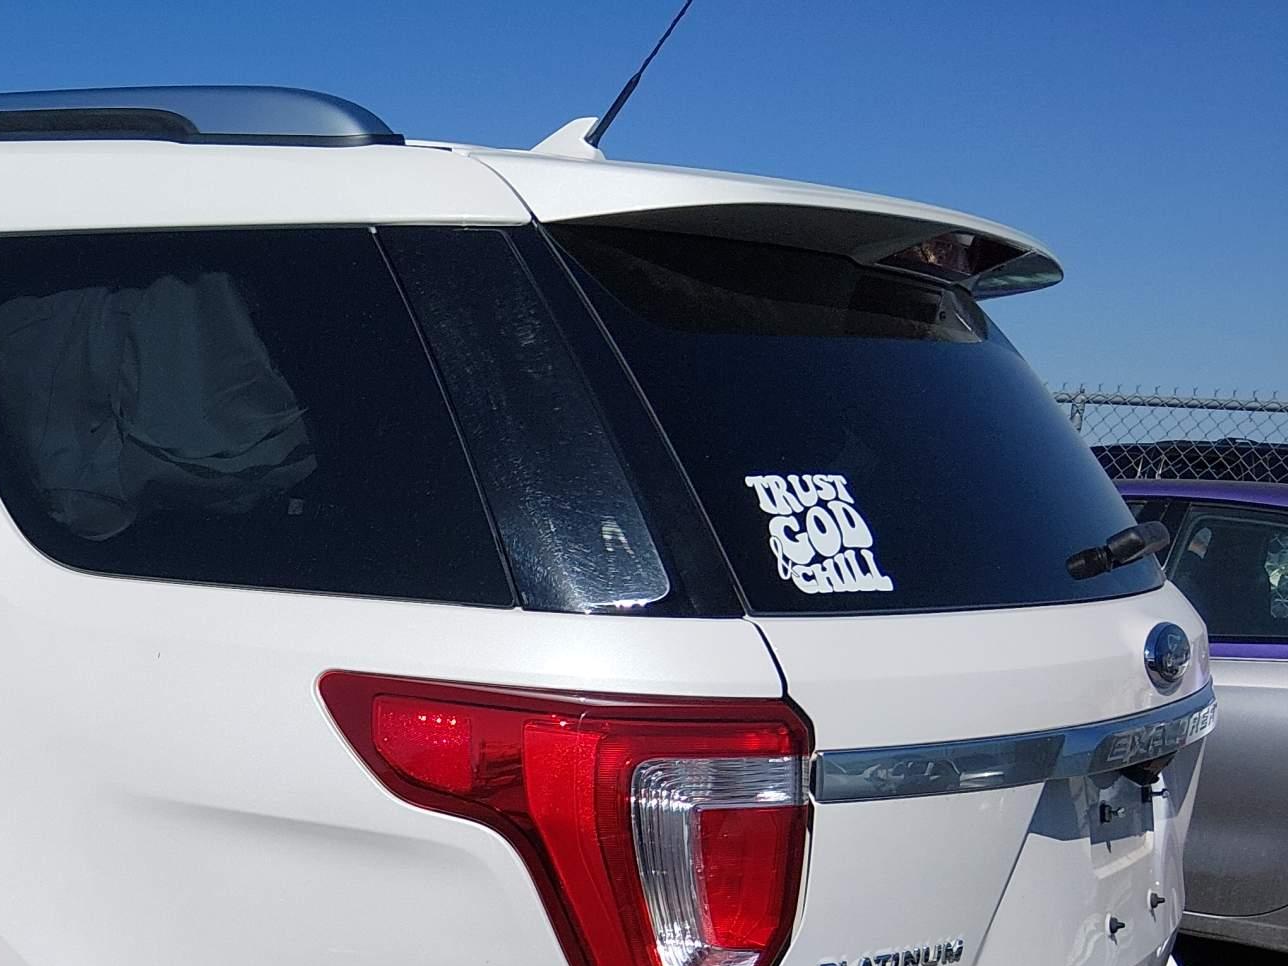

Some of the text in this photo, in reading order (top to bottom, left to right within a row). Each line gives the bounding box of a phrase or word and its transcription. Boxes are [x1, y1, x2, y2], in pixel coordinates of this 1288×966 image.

[744, 474, 855, 516] TRUST
[768, 500, 874, 565] GOD
[791, 548, 894, 594] CHILL
